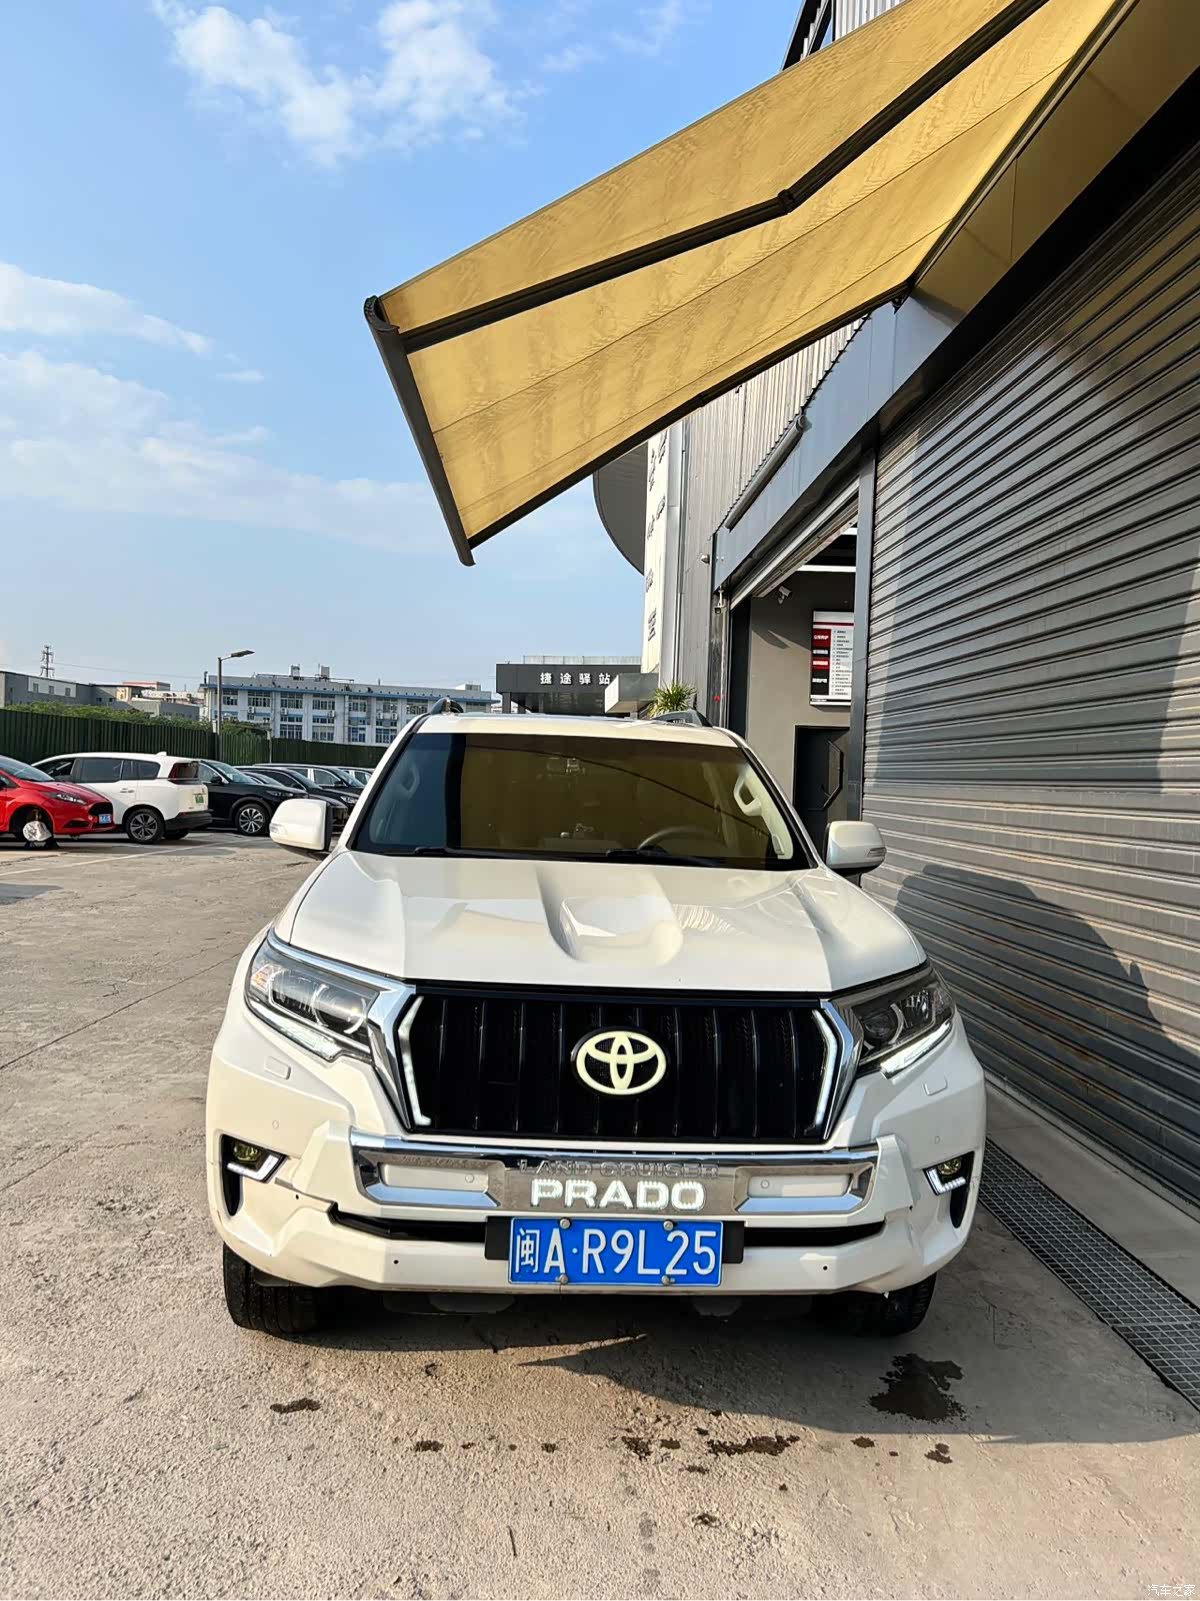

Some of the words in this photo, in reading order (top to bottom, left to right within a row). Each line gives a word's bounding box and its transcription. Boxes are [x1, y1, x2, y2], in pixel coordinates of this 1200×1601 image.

[540, 672, 611, 685] 捷途驿站
[518, 1159, 593, 1176] LAND
[600, 1161, 720, 1178] CRUISER
[530, 1178, 706, 1211] PRADO
